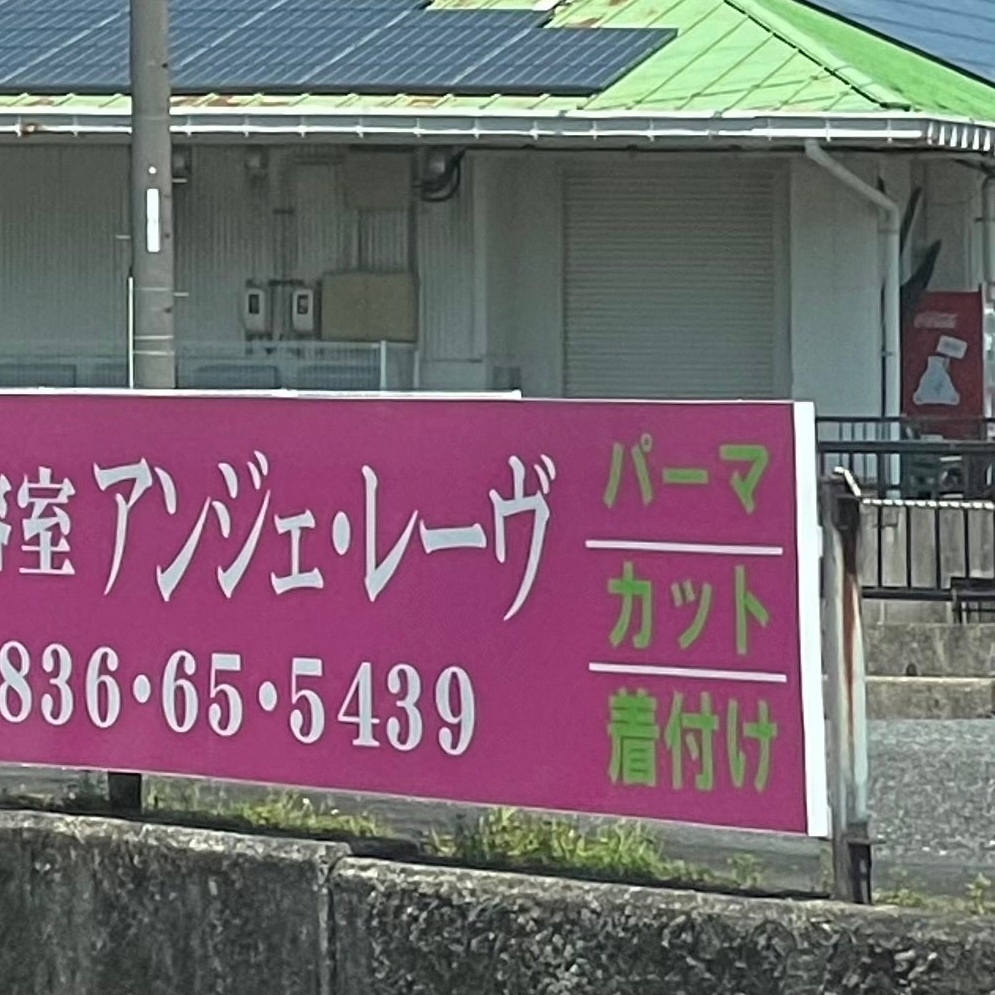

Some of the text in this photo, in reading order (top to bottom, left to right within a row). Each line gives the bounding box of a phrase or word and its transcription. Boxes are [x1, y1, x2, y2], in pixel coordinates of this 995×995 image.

[602, 433, 771, 515] パーマ
[93, 450, 556, 621] アンジェ・レーヴ
[607, 560, 770, 656] カット
[607, 686, 778, 792] 着付け
